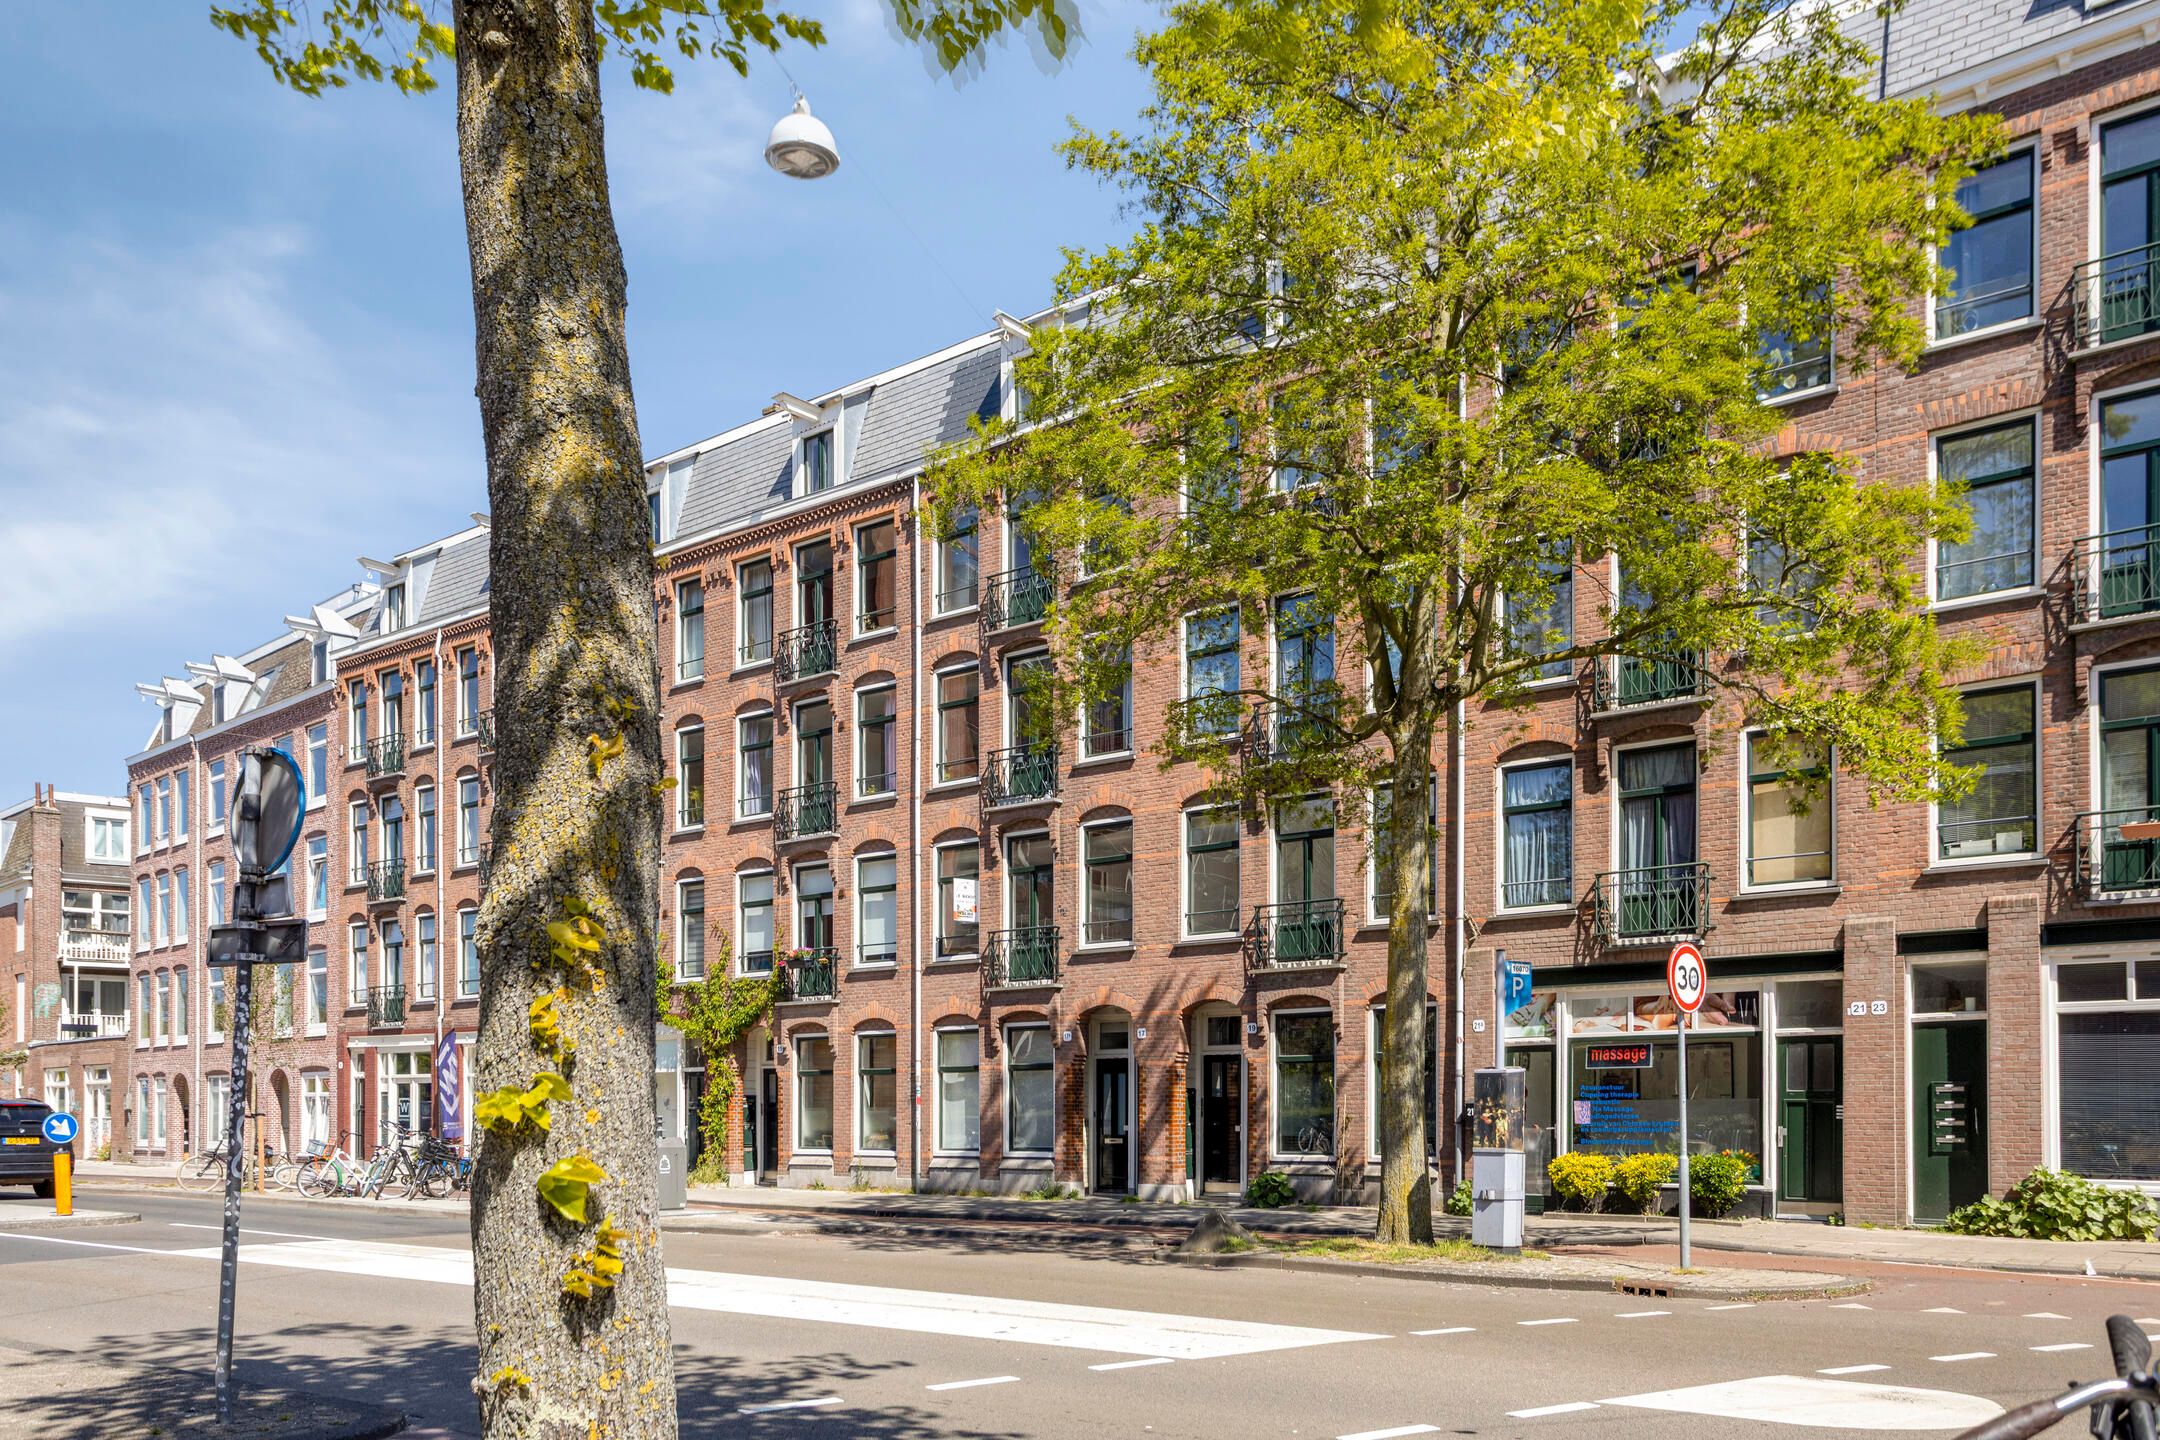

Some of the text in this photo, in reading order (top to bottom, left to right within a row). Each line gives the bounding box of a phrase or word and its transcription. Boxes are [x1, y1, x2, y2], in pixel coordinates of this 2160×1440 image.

[1677, 965, 1699, 991] 30
[1512, 976, 1524, 998] P
[1853, 1004, 1865, 1013] 21
[1873, 1003, 1886, 1012] 23
[1591, 1047, 1647, 1063] massage
